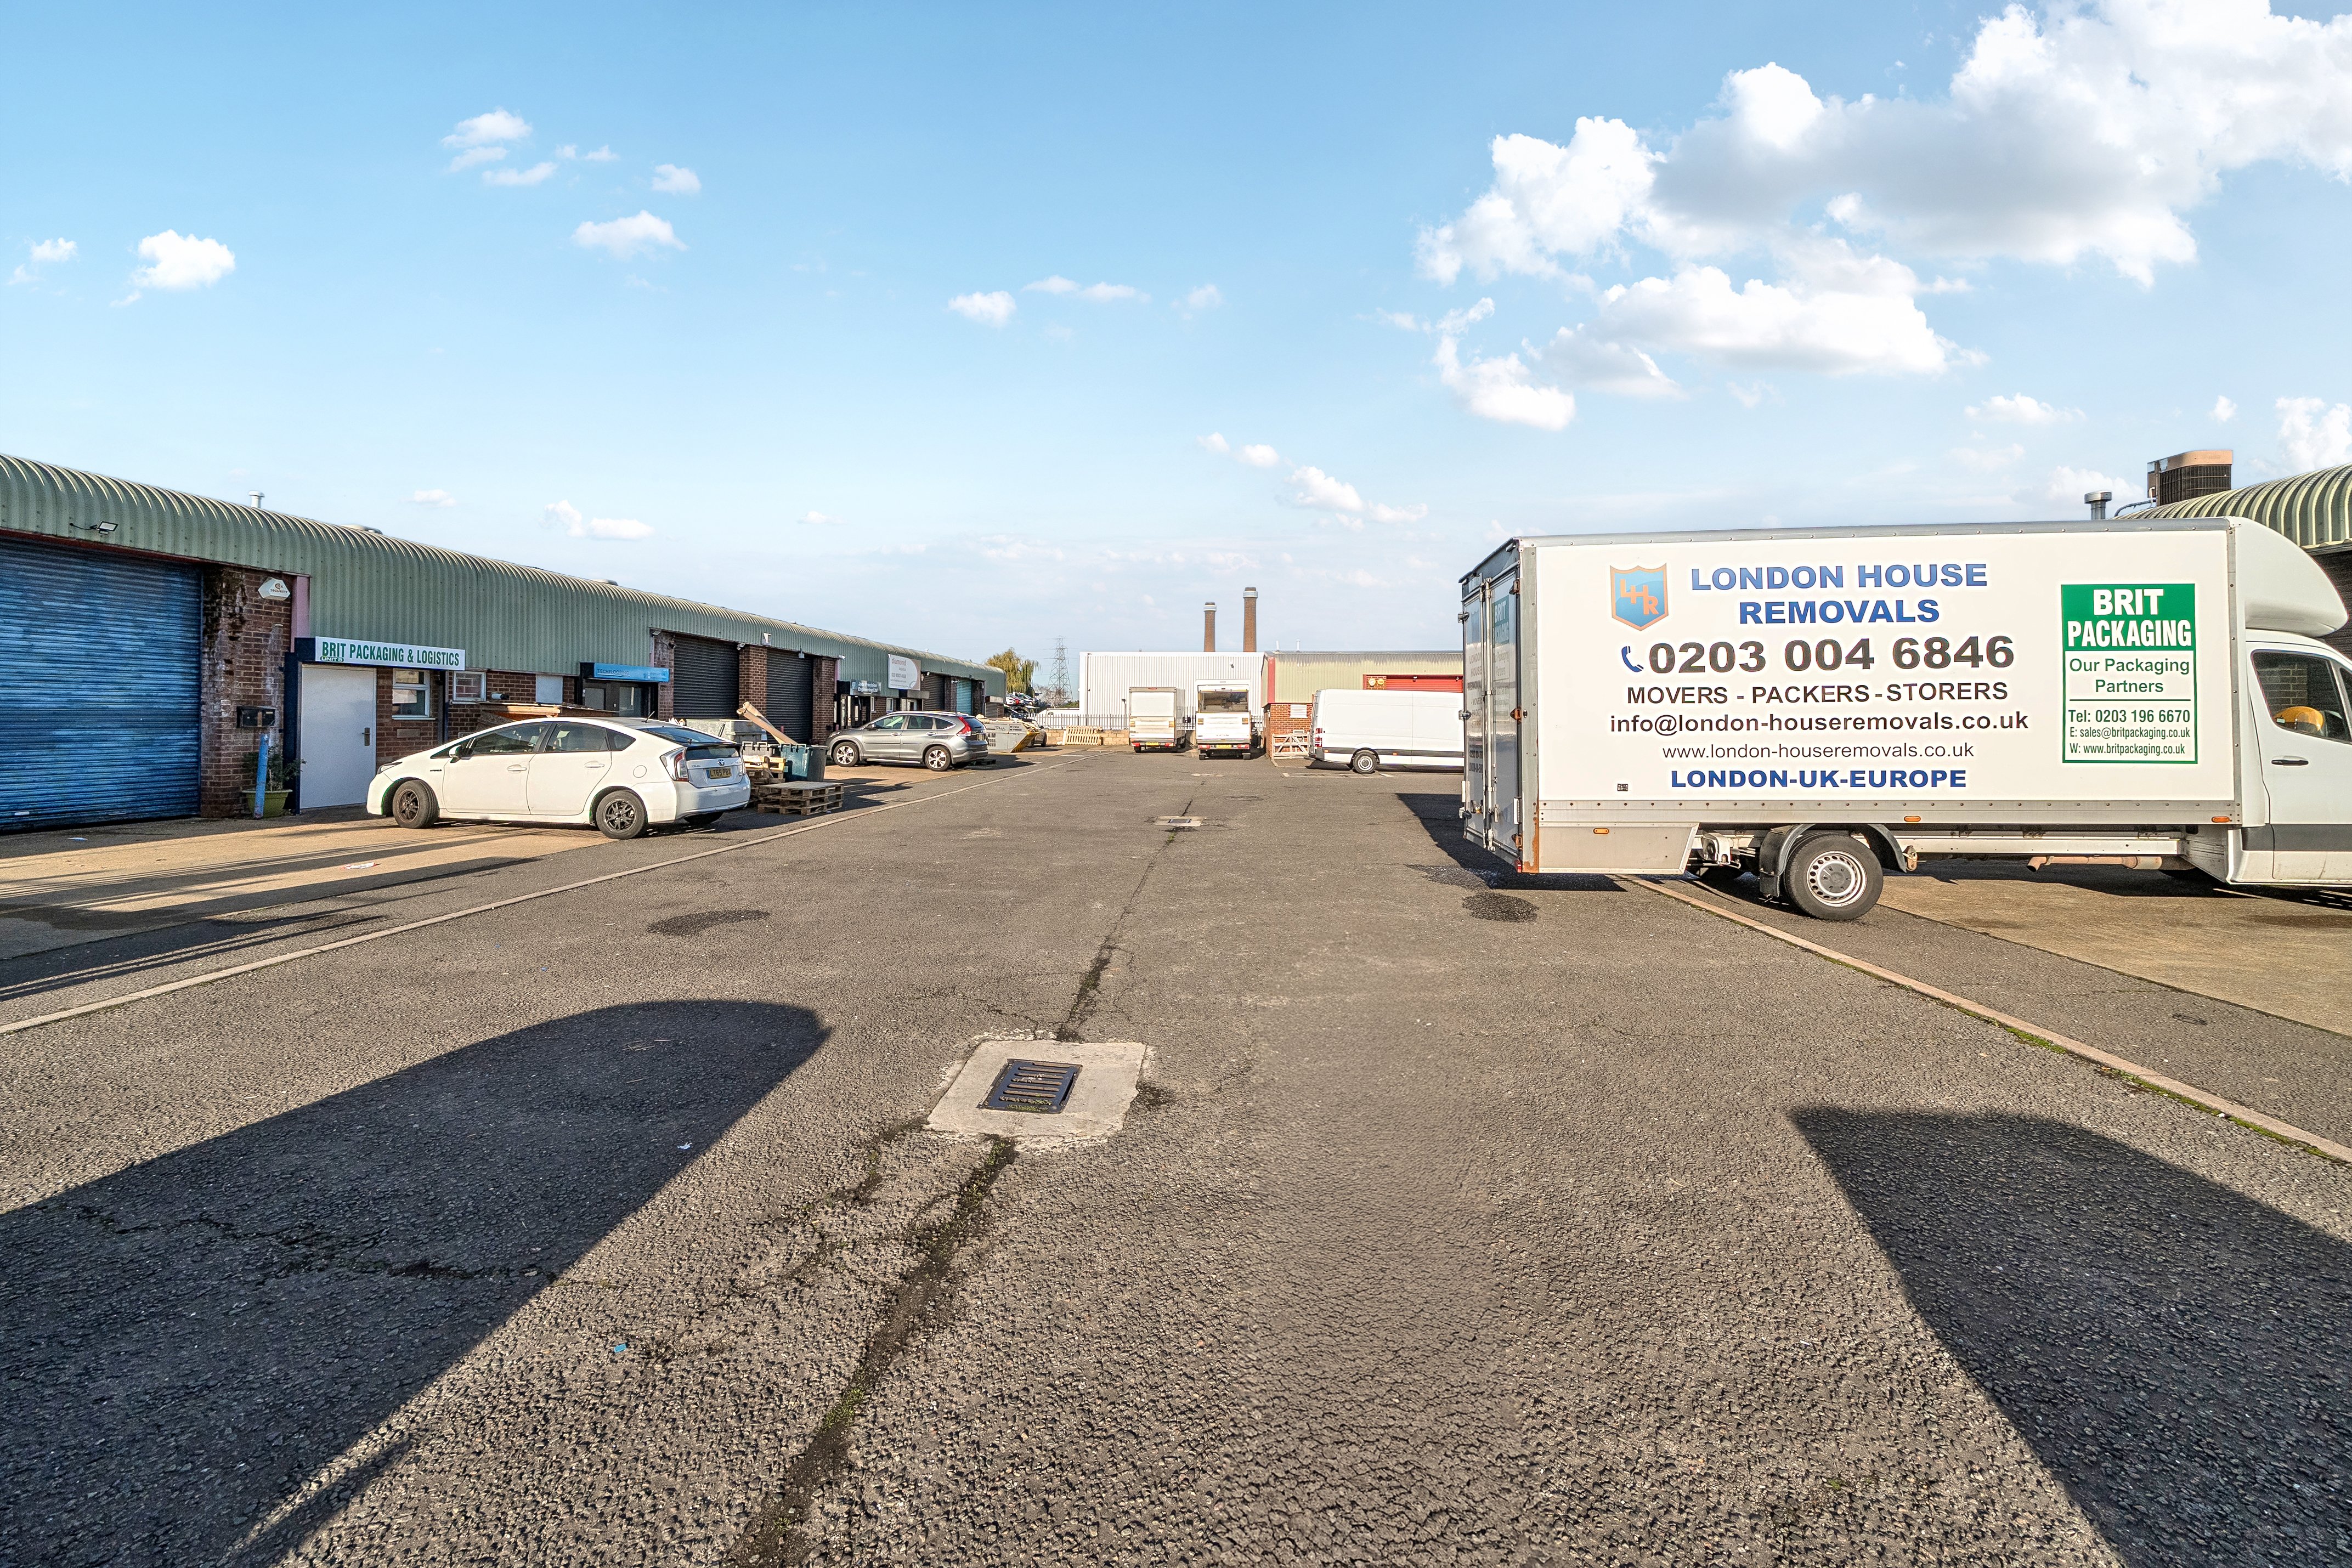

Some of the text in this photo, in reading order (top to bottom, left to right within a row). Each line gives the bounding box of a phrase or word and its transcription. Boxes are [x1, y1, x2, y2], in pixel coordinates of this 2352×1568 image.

[1692, 563, 1987, 591] LONDON HOUSE
[1494, 600, 1506, 624] BRIT
[1739, 599, 1940, 624] REMOVALS
[2093, 588, 2164, 615] BRIT
[2067, 619, 2192, 647] PACKAGING
[322, 641, 460, 666] BRIT PACKAGING & LOGISTICS
[1649, 635, 2014, 674] 0203 004 6846
[2070, 658, 2190, 675] Our Packaging
[1627, 687, 1728, 704] MOVERS
[1752, 684, 1869, 704] PACKERS
[1886, 682, 2008, 701] STORERS
[2095, 679, 2164, 693] Partners
[1611, 711, 2028, 737] info@london-houseremovals.co.uk
[2068, 710, 2190, 723] Tel: 0203 196 6670
[2070, 727, 2190, 740] E: sales@britpackaging.co.uk
[1663, 742, 1974, 758] www.london-houseremovals.co.uk
[2070, 743, 2185, 756] W: www.britpackaging.co.uk
[1671, 769, 1966, 788] LONDON-UK-EUROPE
